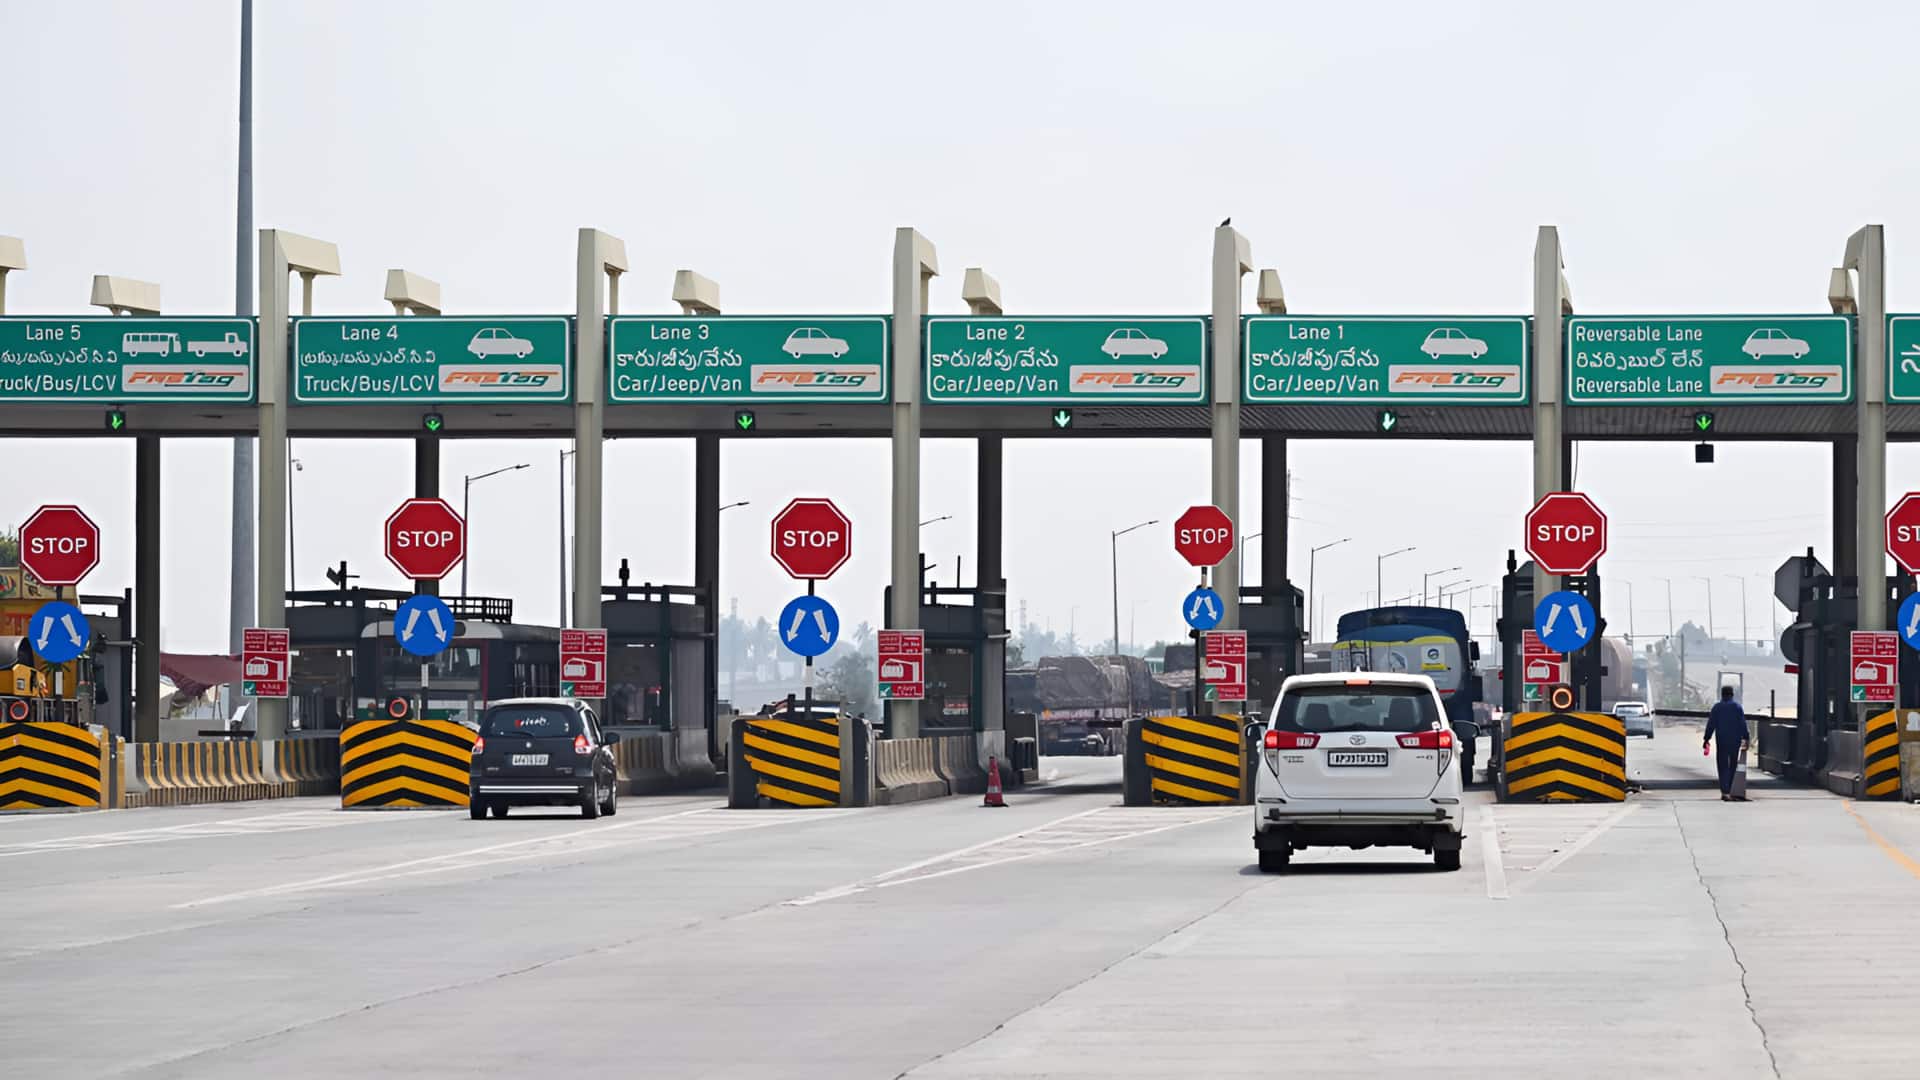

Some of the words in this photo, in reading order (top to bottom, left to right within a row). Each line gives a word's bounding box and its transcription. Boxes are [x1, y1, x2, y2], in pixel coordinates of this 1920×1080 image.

[27, 326, 63, 340] Lane
[71, 325, 80, 340] 5
[342, 326, 380, 340] Lane
[387, 326, 397, 339] 4
[651, 325, 691, 339] Lane
[699, 325, 708, 339] 3
[967, 325, 1007, 340] Lane
[1015, 325, 1024, 339] 2
[1290, 324, 1330, 339] Lane
[1338, 325, 1343, 339] 1
[1577, 326, 1660, 341] Reversable
[1668, 326, 1702, 340] Lane
[0, 375, 116, 392] uck/Bus/LCV
[304, 375, 434, 392] Truck/Bus/LCV
[618, 375, 741, 392] Car/Jeep/Van
[933, 375, 1058, 393] Car/Jeep/Van
[1253, 375, 1378, 392] Car/Jeep/Van
[1577, 377, 1660, 392] Reversable
[1668, 376, 1702, 392] Lane
[398, 531, 453, 547] STOP
[784, 531, 839, 547] STOP
[1181, 528, 1228, 544] STOP
[1538, 525, 1594, 541] STOP
[1898, 526, 1920, 541] ST
[32, 538, 87, 554] STOP
